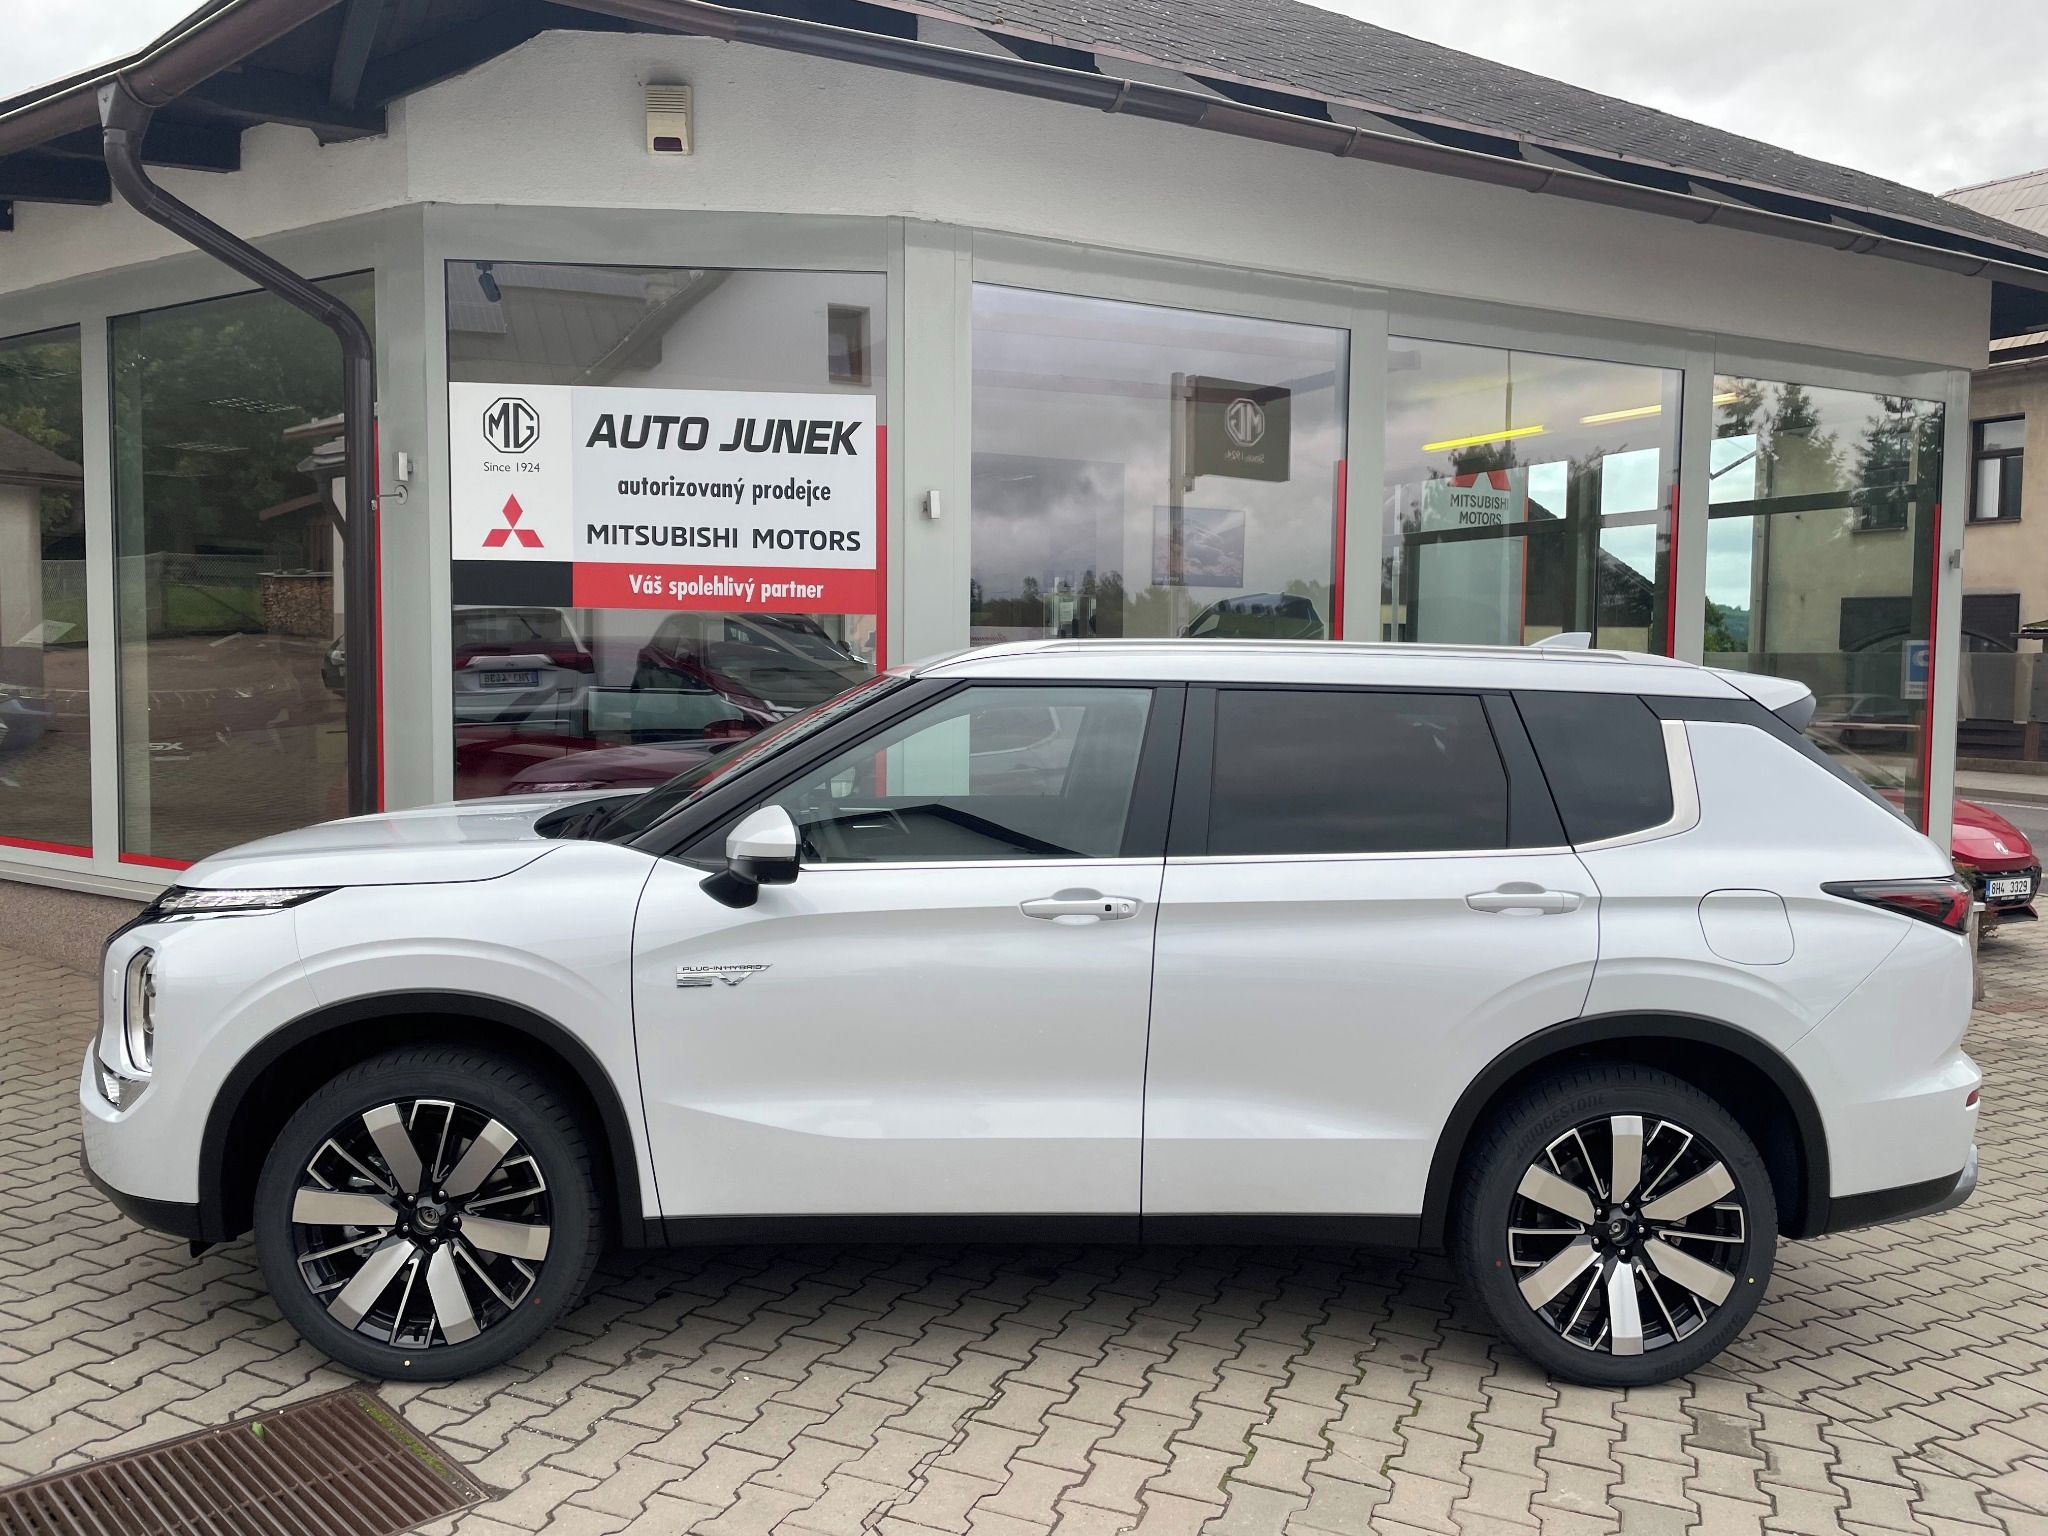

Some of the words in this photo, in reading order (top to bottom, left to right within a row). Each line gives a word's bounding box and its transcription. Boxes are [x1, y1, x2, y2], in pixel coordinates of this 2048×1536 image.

[488, 402, 535, 449] MG
[585, 414, 709, 450] AUTO
[719, 418, 862, 455] JUNEK
[483, 461, 511, 472] Since
[516, 462, 540, 472] 1924
[617, 475, 745, 504] autorizovaný
[752, 477, 831, 506] prodejce
[1450, 494, 1509, 510] MITSUBISHI
[1459, 511, 1502, 525] MOTORS
[587, 523, 738, 548] MITSUBISHI
[752, 528, 861, 551] MOTORS
[629, 574, 662, 594] Váš
[669, 574, 755, 602] spolehlivý
[761, 583, 824, 602] partner
[2010, 880, 2028, 893] 3329
